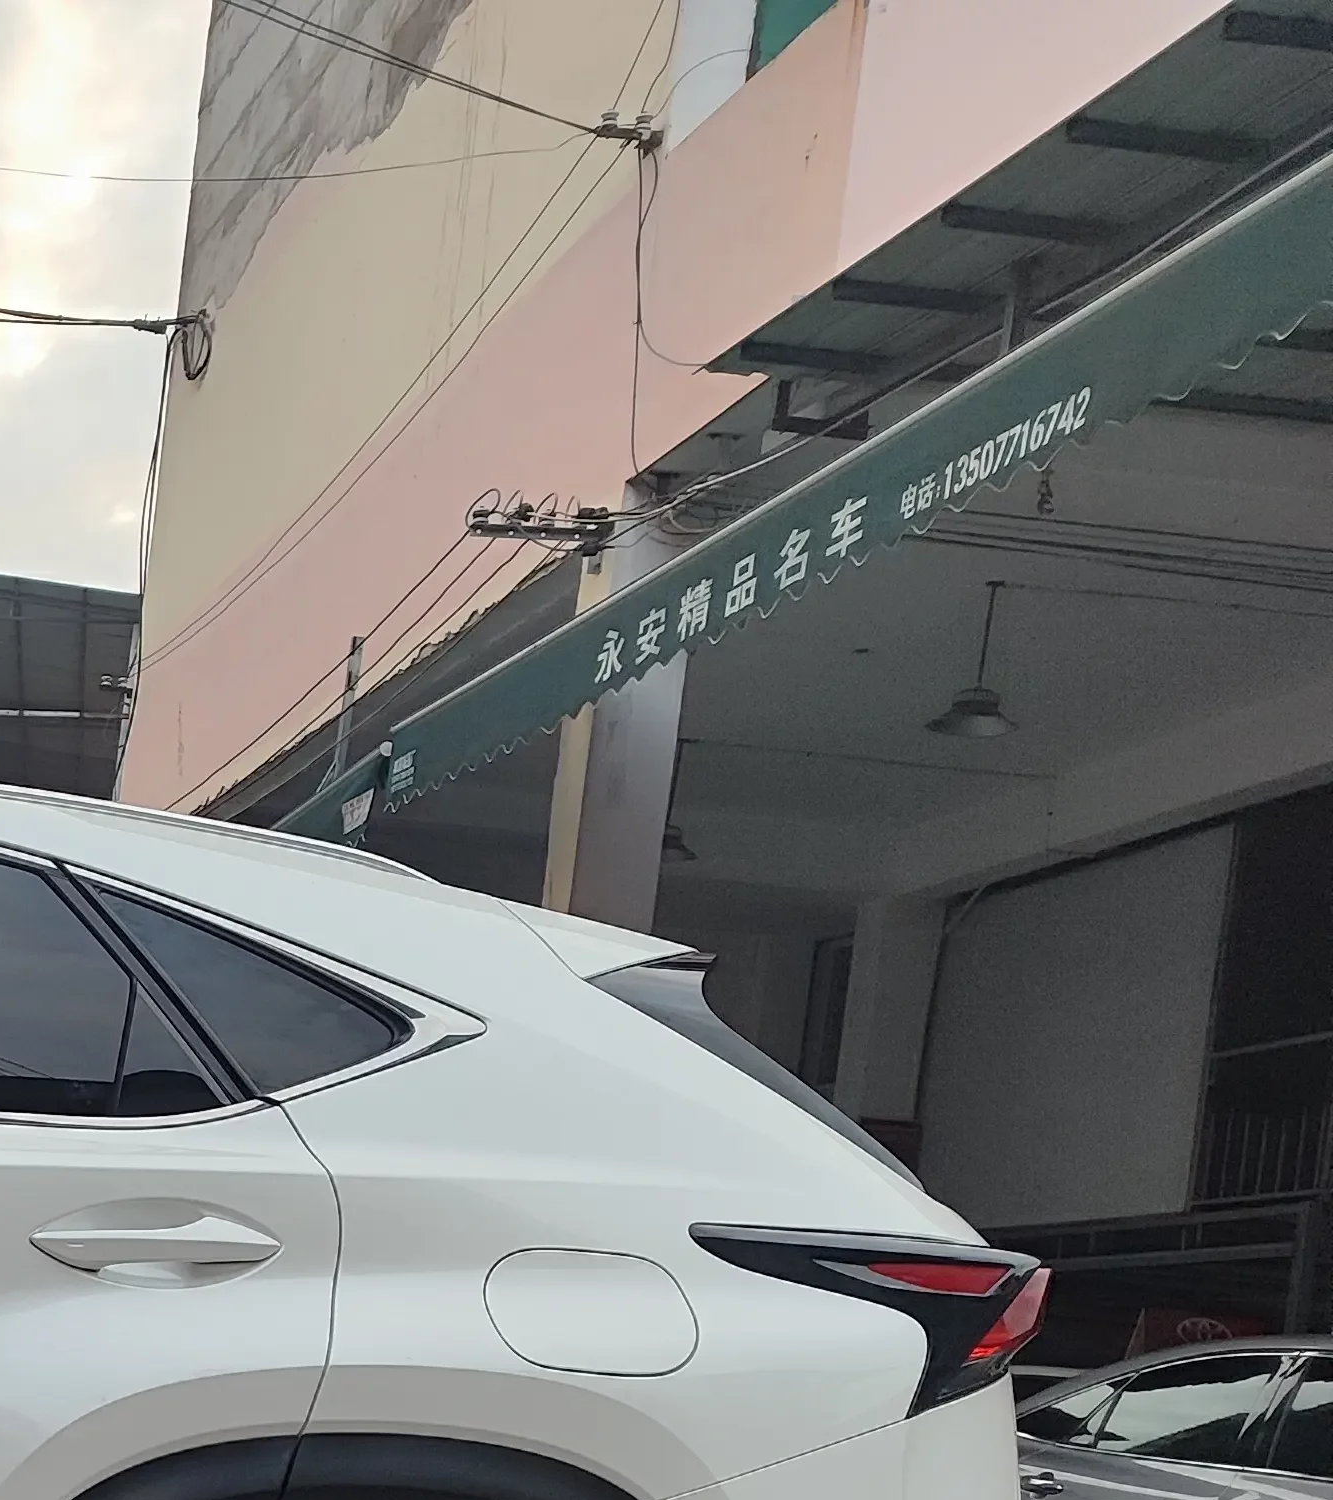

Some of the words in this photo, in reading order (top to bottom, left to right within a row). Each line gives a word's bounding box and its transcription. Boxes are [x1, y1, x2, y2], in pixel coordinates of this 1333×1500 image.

[594, 496, 868, 684] 永安精品名车
